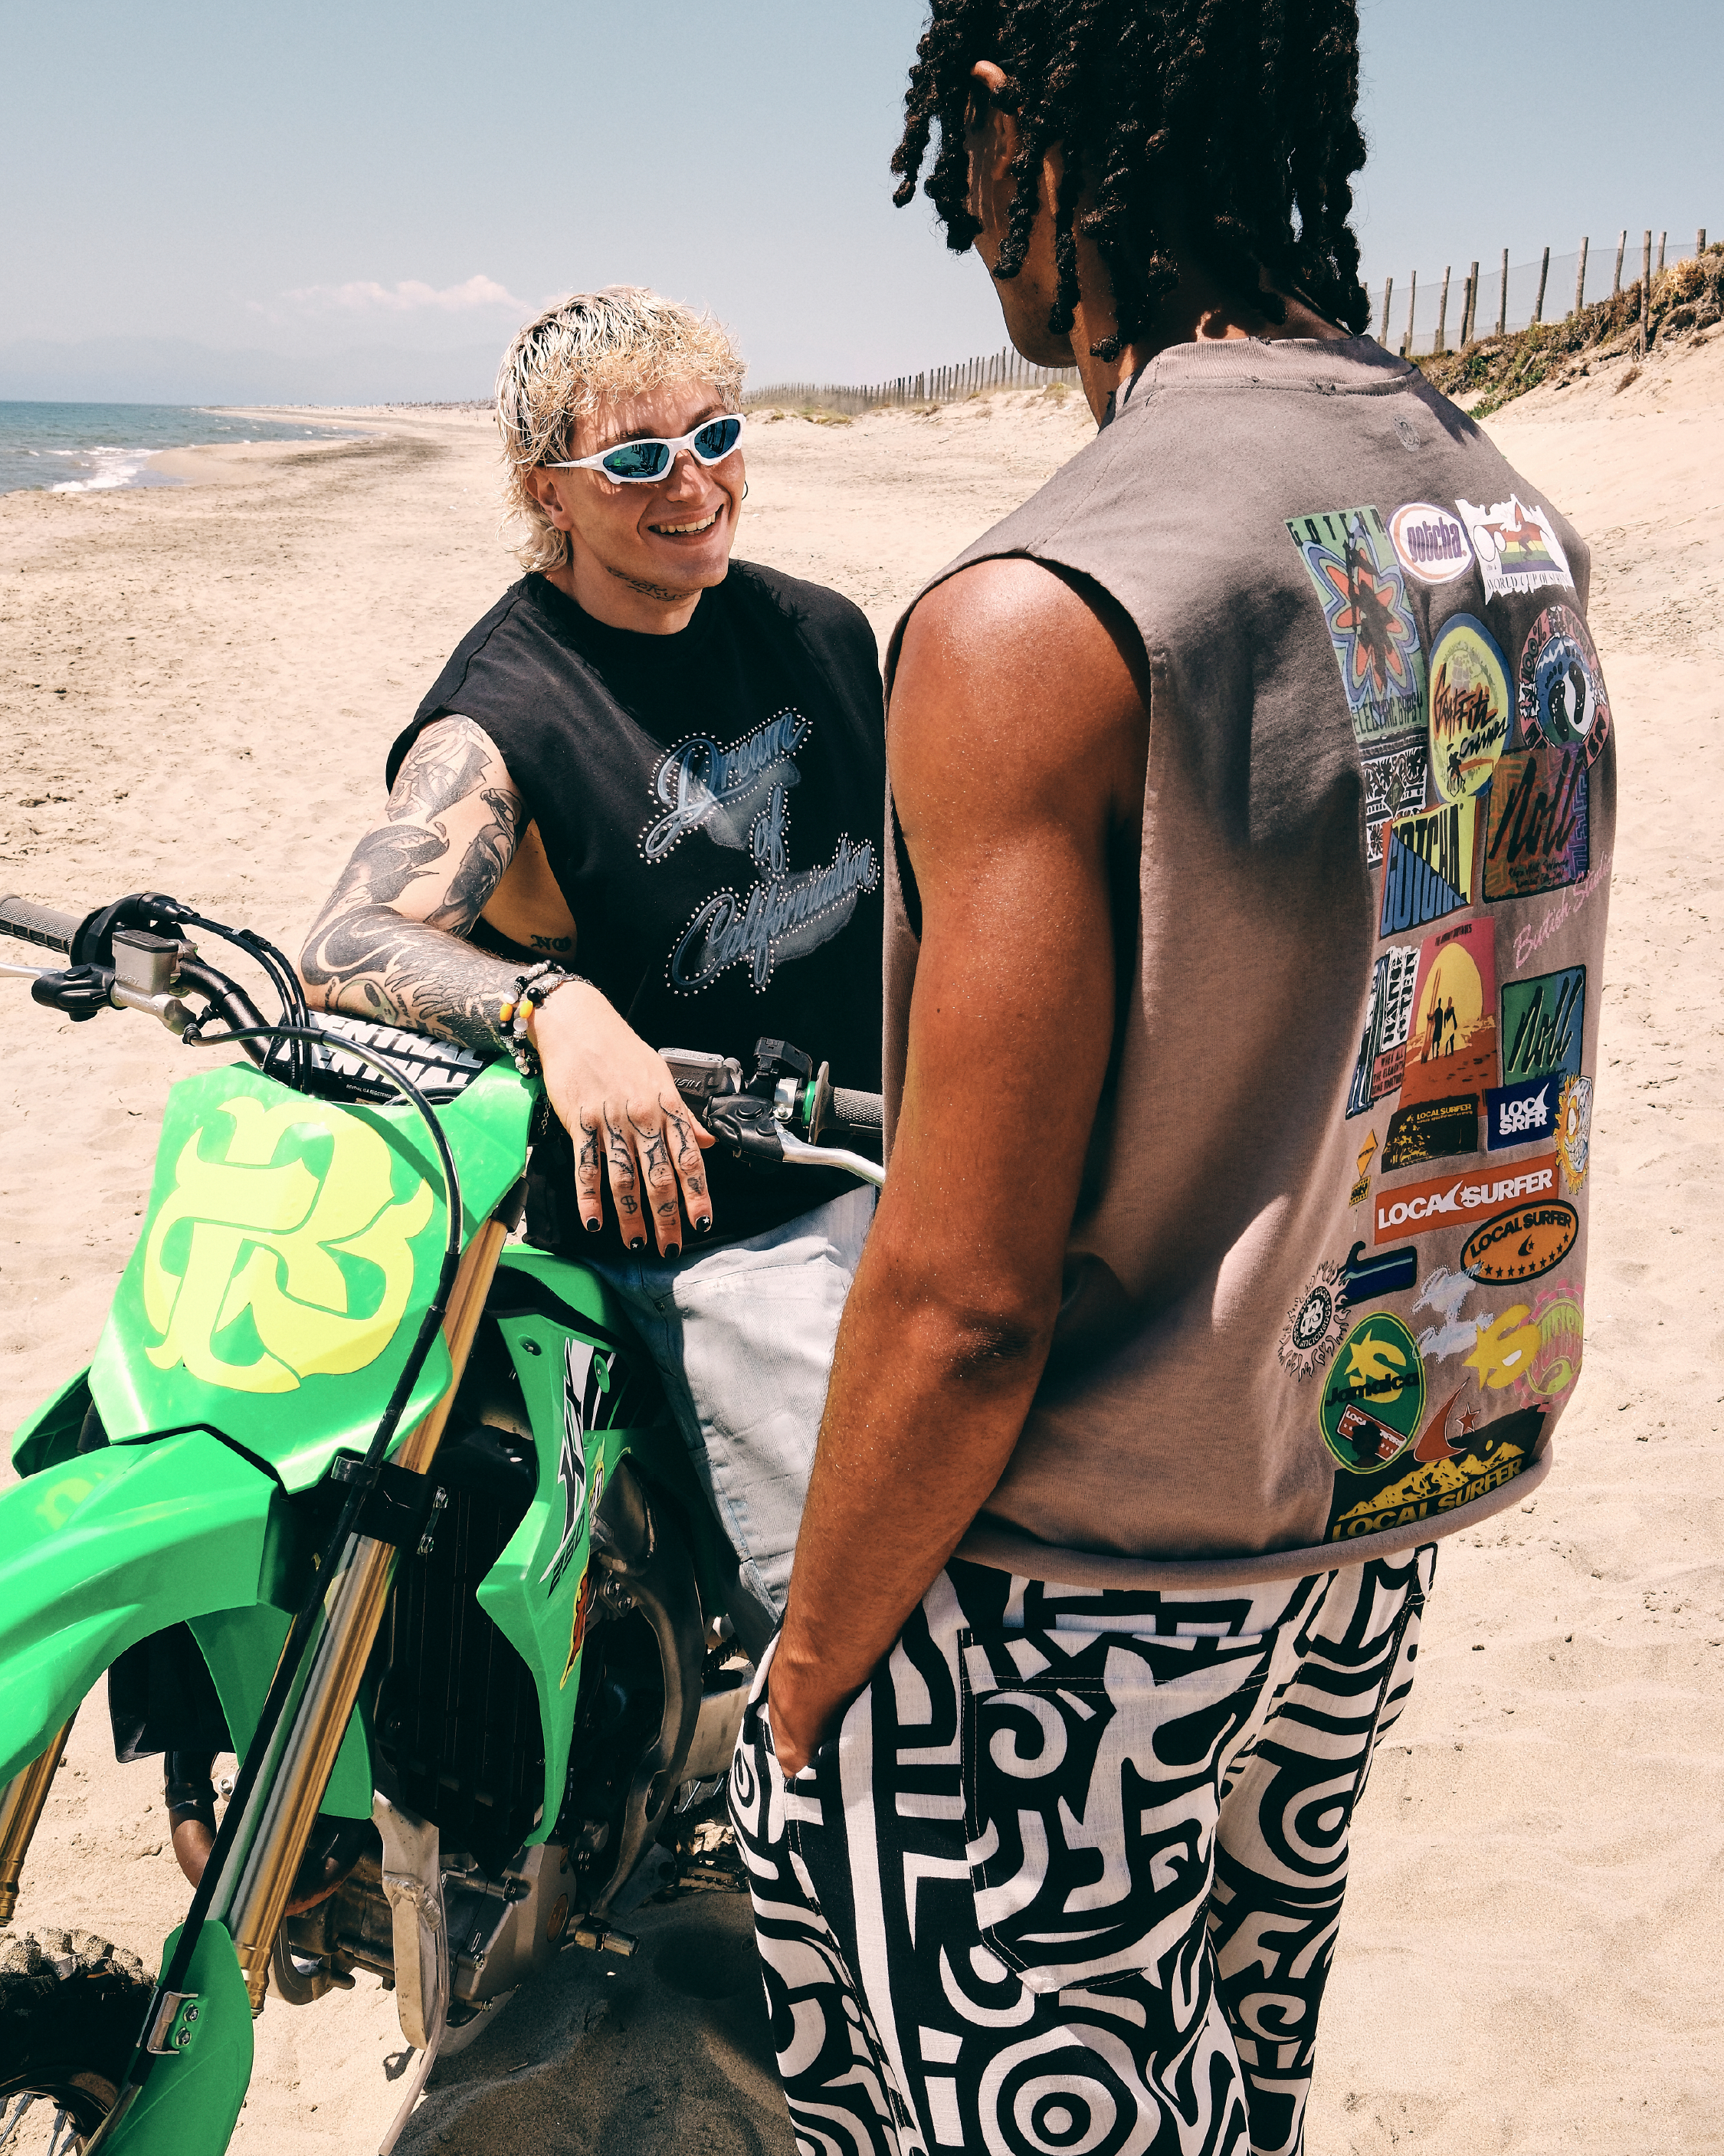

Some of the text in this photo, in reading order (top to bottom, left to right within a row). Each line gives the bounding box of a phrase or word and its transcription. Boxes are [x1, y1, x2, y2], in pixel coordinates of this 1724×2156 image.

[1486, 575, 1517, 590] WORLD
[645, 712, 807, 857] Dream
[753, 786, 785, 873] of
[671, 837, 877, 986] California
[1417, 1108, 1440, 1120] LOCAL
[1440, 1103, 1472, 1115] SURFER
[1462, 1168, 1552, 1208] SURFER
[1470, 1209, 1572, 1258] LOCAL SURFER
[1325, 1372, 1419, 1406] Jamaica
[1332, 1458, 1522, 1543] LOCAL SURFER
